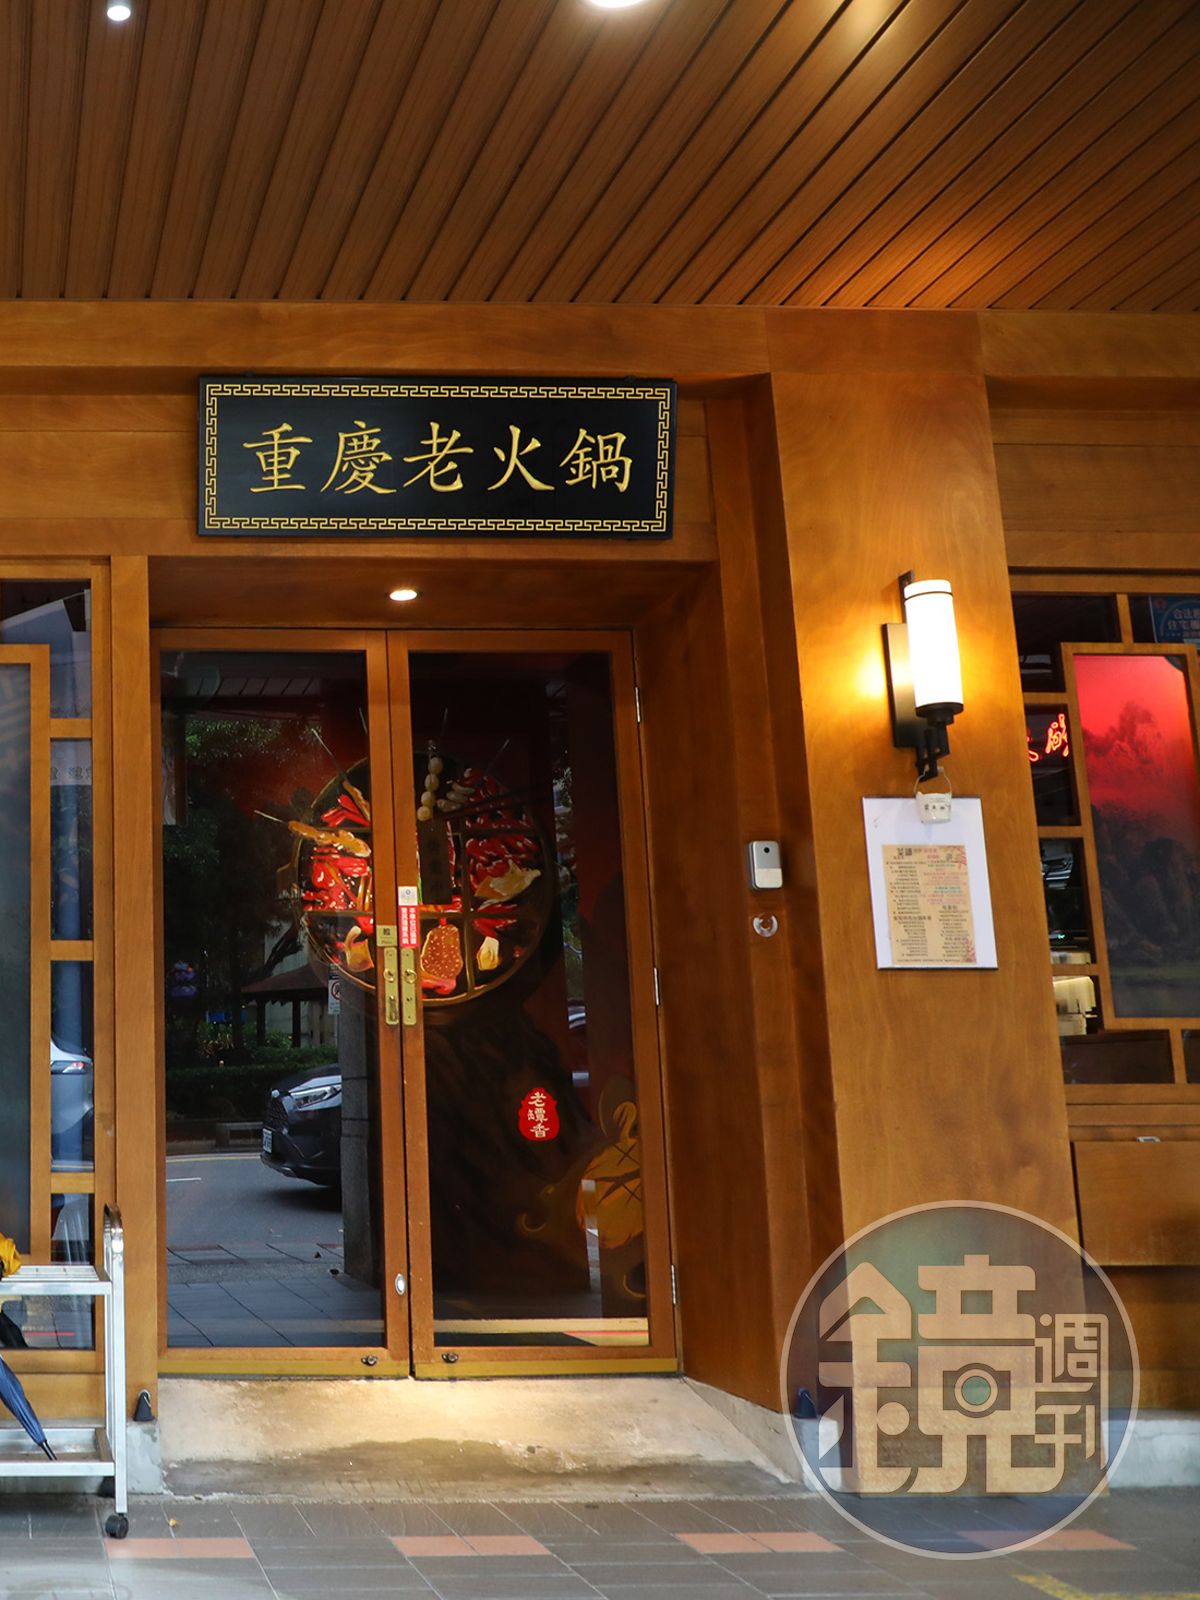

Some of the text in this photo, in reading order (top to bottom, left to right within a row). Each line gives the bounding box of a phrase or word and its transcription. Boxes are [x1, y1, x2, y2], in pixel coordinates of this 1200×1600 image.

[242, 420, 633, 495] 重慶老火鍋
